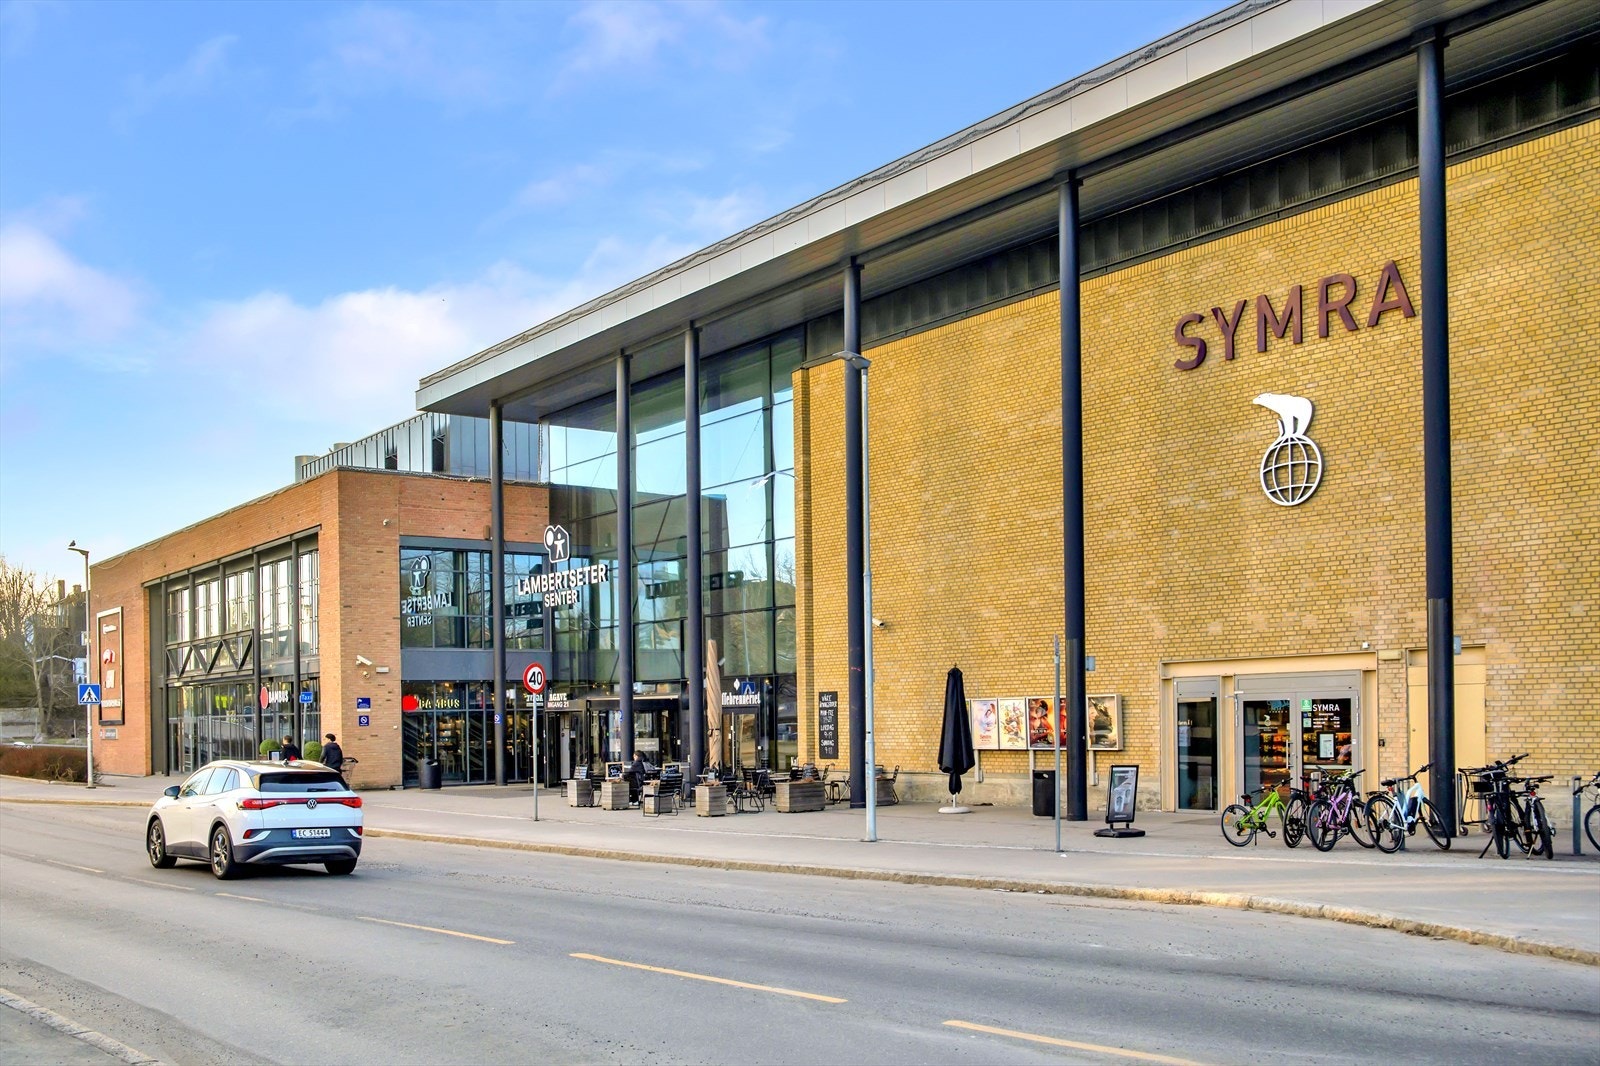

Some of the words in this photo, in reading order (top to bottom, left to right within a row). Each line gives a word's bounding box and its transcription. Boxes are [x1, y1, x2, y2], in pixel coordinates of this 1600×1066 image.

[1174, 260, 1416, 370] SYMRA
[517, 564, 608, 596] LAMBERTSETER
[544, 590, 579, 608] SENTER
[528, 671, 543, 686] 40
[269, 690, 289, 703] BAMBUS
[549, 693, 568, 702] AGAVE
[721, 691, 761, 705] ffebrenneriet
[1312, 703, 1341, 712] SYMRA
[298, 829, 307, 837] EC
[309, 829, 329, 837] 51444
